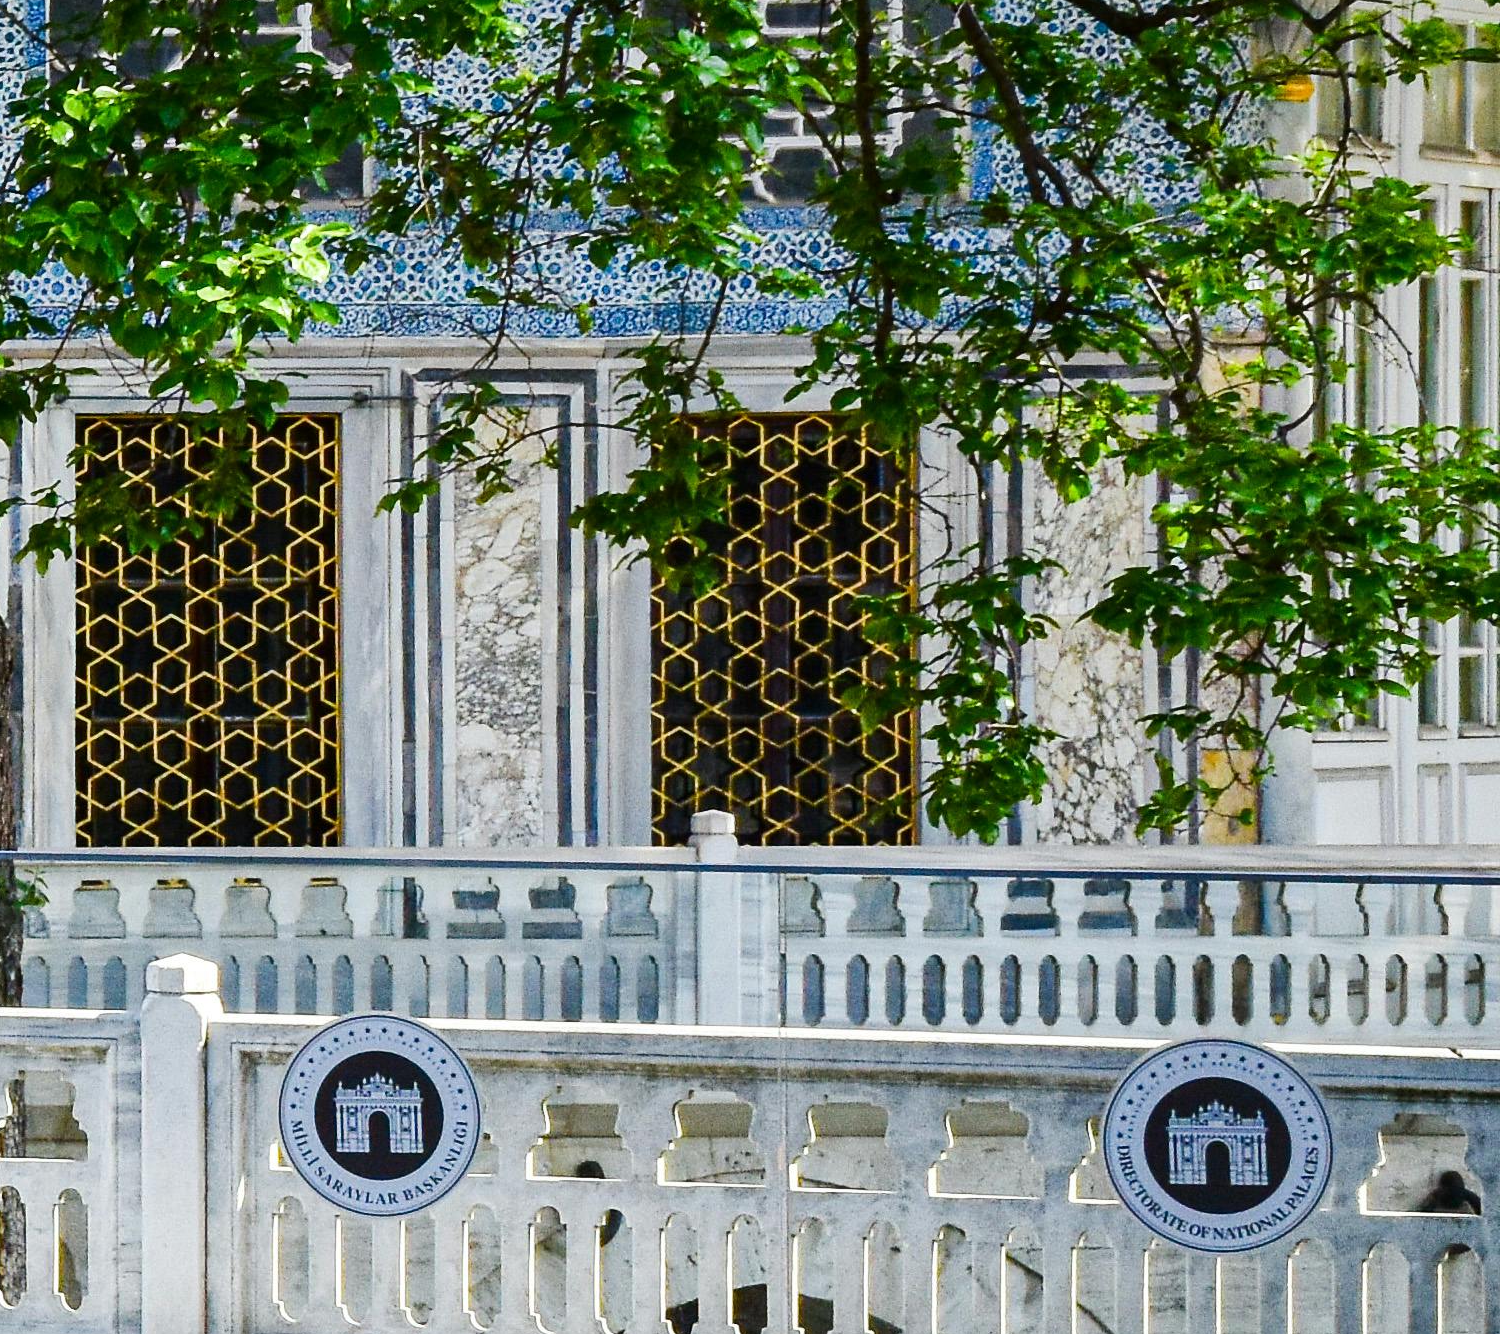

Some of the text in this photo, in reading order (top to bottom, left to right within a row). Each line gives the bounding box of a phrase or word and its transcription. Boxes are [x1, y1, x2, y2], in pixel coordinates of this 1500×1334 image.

[291, 1120, 468, 1205] MİLLİ SARAYLAR BAŞKANLIĞI
[1117, 1145, 1319, 1240] DIRECTORATE OF NATIONAL PALACES
